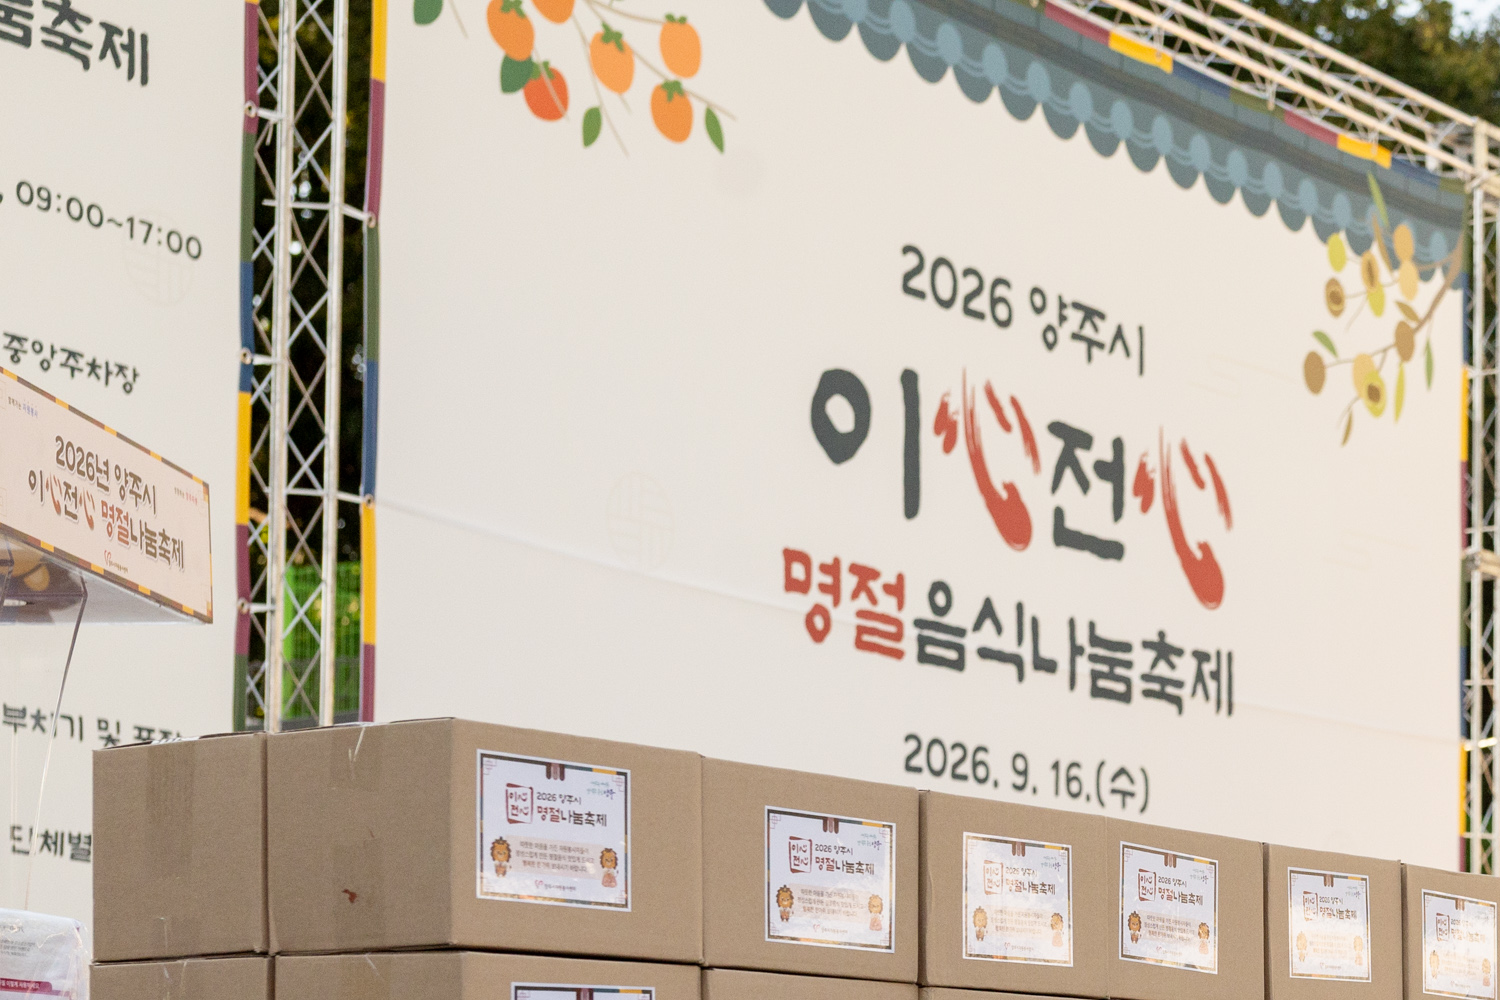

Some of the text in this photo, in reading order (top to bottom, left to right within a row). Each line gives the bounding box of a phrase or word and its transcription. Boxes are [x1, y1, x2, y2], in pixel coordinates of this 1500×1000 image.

[16, 181, 203, 260] 09:00~17:00
[901, 244, 1145, 377] 2026 양주시
[3, 332, 140, 394] 중앙주차장
[55, 435, 156, 515] 2026년 양주시
[101, 499, 184, 569] 명절나눔축제
[783, 547, 1235, 717] 명절음식나눔축제
[904, 733, 999, 787] 2026.
[536, 790, 556, 801] 2026
[536, 803, 607, 827] 명절나눔축제
[816, 844, 832, 854] 2026
[816, 856, 875, 877] 명절나눔축제
